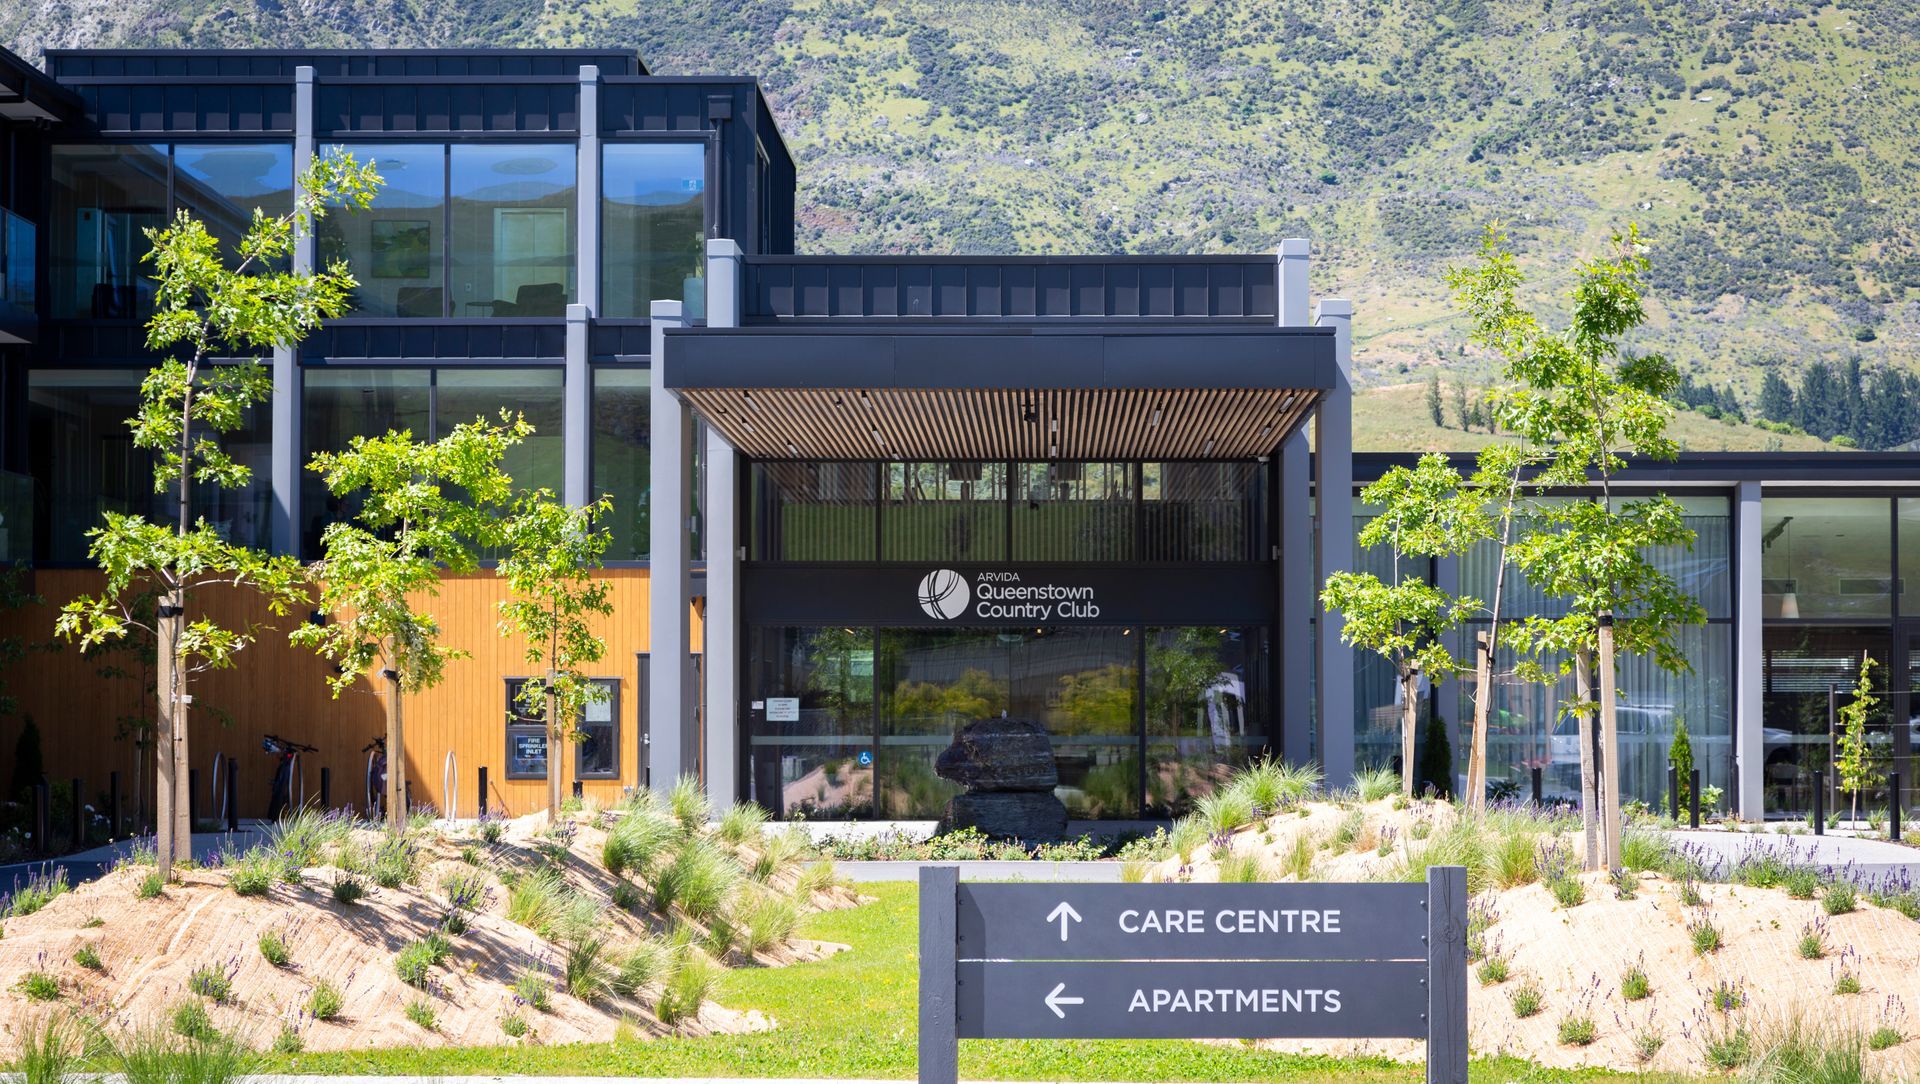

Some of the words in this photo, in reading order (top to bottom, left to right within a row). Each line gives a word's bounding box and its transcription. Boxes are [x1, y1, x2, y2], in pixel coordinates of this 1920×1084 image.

[977, 572, 1021, 582] ARVIDA
[976, 583, 1094, 600] Queenstown
[976, 601, 1052, 620] Country
[1057, 601, 1100, 618] Club
[1118, 909, 1205, 933] CARE
[1214, 909, 1341, 933] CENTRE
[1128, 988, 1342, 1013] APARTMENTS
